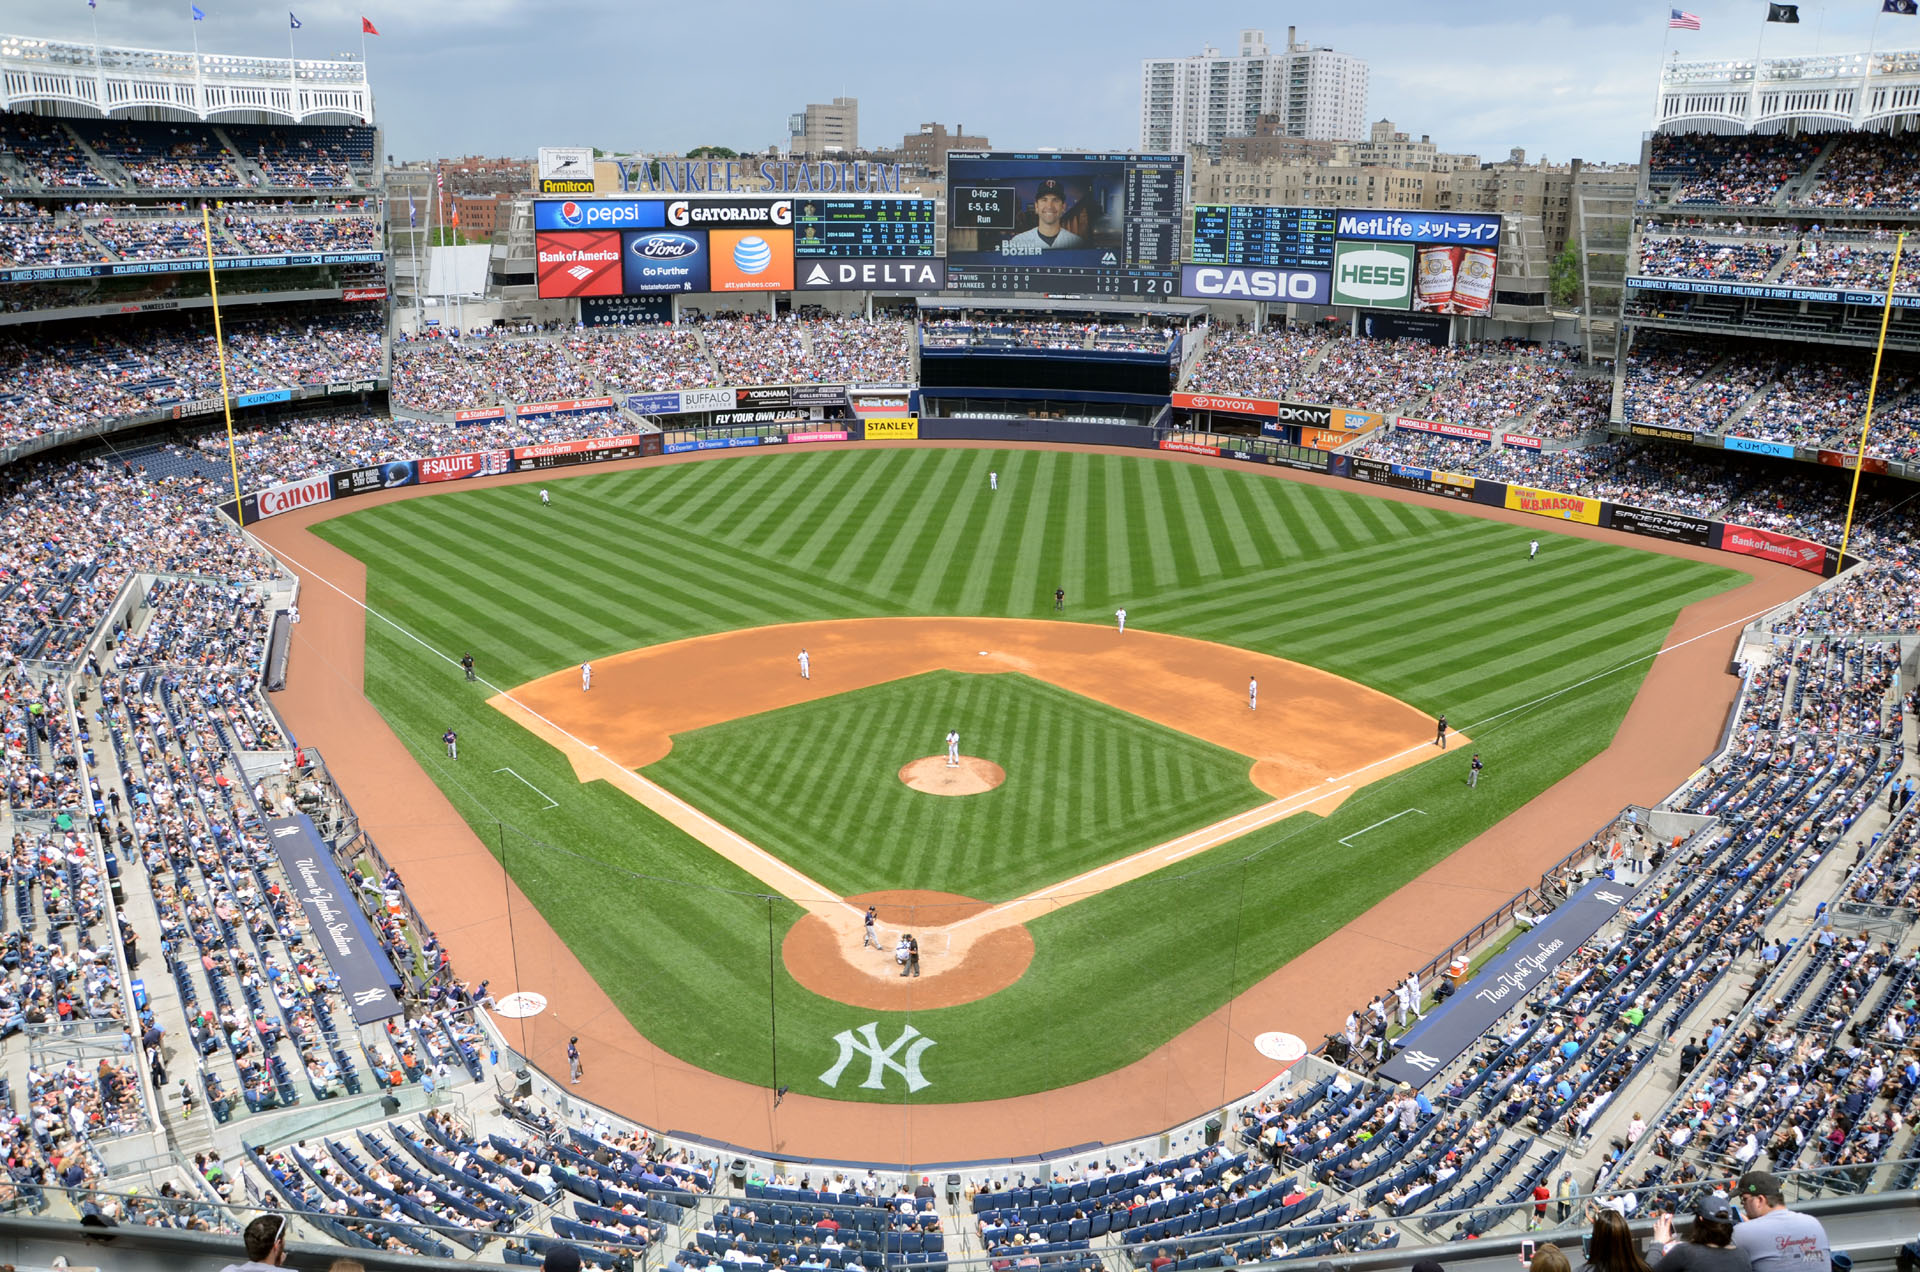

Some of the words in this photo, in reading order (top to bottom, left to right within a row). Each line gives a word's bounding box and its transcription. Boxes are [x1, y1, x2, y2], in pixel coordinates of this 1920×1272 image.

[618, 161, 741, 192] YANKEE
[760, 161, 901, 193] STADIUM
[544, 180, 594, 192] Armitron
[972, 190, 998, 198] 0-for-2
[968, 202, 983, 212] E-5,
[985, 202, 1000, 212] E-9,
[588, 204, 638, 224] pepsi
[691, 207, 768, 222] GATORADE
[977, 214, 991, 223] Run
[1338, 215, 1412, 237] MetLife
[1417, 221, 1499, 240] メットライフ
[644, 238, 686, 256] Ford
[1002, 247, 1042, 256] DOZIER
[324, 254, 381, 263] GOVX.COM/YANKEES
[540, 251, 566, 262] Bank
[566, 250, 578, 262] of
[578, 250, 619, 261] America
[112, 264, 148, 274] EXCLUSIVELY
[149, 263, 168, 272] PRICED
[169, 262, 191, 271] TICKETS
[204, 260, 230, 268] MITARY
[235, 259, 250, 267] FIRST
[252, 257, 287, 266] RESPONDERS
[643, 268, 656, 276] Go
[657, 267, 688, 276] Further
[11, 269, 56, 281] YANKEES-STEINER
[56, 267, 92, 278] COLLECTIBLES
[840, 264, 937, 284] DELTA
[1341, 264, 1405, 286] HESS
[724, 280, 781, 290] att.yankees.com
[1133, 279, 1138, 292] 1
[1147, 280, 1156, 293] 2
[1163, 280, 1172, 293] 0
[1195, 268, 1317, 299] CASIO
[344, 290, 386, 300] Budweiser
[1628, 279, 1666, 291] EXCLUSIVELY
[1668, 281, 1690, 292] PRICED
[1691, 282, 1717, 293] TICKETS
[1718, 284, 1731, 294] FOR
[1732, 285, 1764, 296] MILITARY
[1771, 288, 1790, 298] FIRST
[1792, 291, 1838, 301] RESPONDERS
[142, 303, 164, 311] YANKEES
[327, 383, 350, 394] Poland
[350, 381, 374, 392] Spring
[248, 392, 282, 403] KUMON
[686, 392, 731, 404] BUFFALO
[749, 390, 789, 398] YOKOHAMA
[181, 399, 224, 413] SYRACUSE
[860, 399, 882, 407] Peanut
[883, 399, 904, 407] Chews
[1210, 398, 1255, 411] TOYOTA
[470, 410, 485, 418] State
[715, 414, 730, 424] FLY
[732, 413, 754, 423] YOUR
[755, 412, 775, 420] OWN
[776, 410, 796, 419] FLAG
[1279, 408, 1330, 425] DKNY
[868, 422, 914, 431] STANLEY
[1264, 422, 1283, 432] FedEx
[1345, 416, 1364, 427] SAP
[1398, 419, 1429, 430] MODELL'S
[1440, 425, 1488, 439] MODELLS.com
[1650, 428, 1693, 440] BUSINESS
[597, 439, 615, 448] State
[615, 438, 632, 446] Farm
[1506, 435, 1538, 446] MODELL'S
[534, 447, 553, 456] State
[554, 445, 571, 453] Farm
[1736, 441, 1780, 454] KUMON
[1234, 451, 1250, 460] 385FT
[422, 456, 474, 476] #SALUTE
[1360, 460, 1383, 469] GATORADE
[352, 471, 364, 480] PLAY
[1406, 469, 1424, 478] pepsi
[353, 478, 366, 487] STAY
[259, 480, 330, 515] Canon
[1615, 510, 1695, 530] SPIDER-MAN
[1696, 524, 1708, 534] 2
[1652, 525, 1680, 534] PLAYING
[1732, 535, 1754, 547] Bank
[1754, 540, 1764, 550] of
[1764, 542, 1798, 558] America
[296, 857, 319, 888] Welcome
[303, 893, 340, 924] Yankee
[326, 922, 352, 957] Stadium
[1475, 982, 1509, 1004] New
[1498, 969, 1532, 991] York
[1519, 938, 1565, 972] Yankees
[820, 1021, 938, 1094] NY
